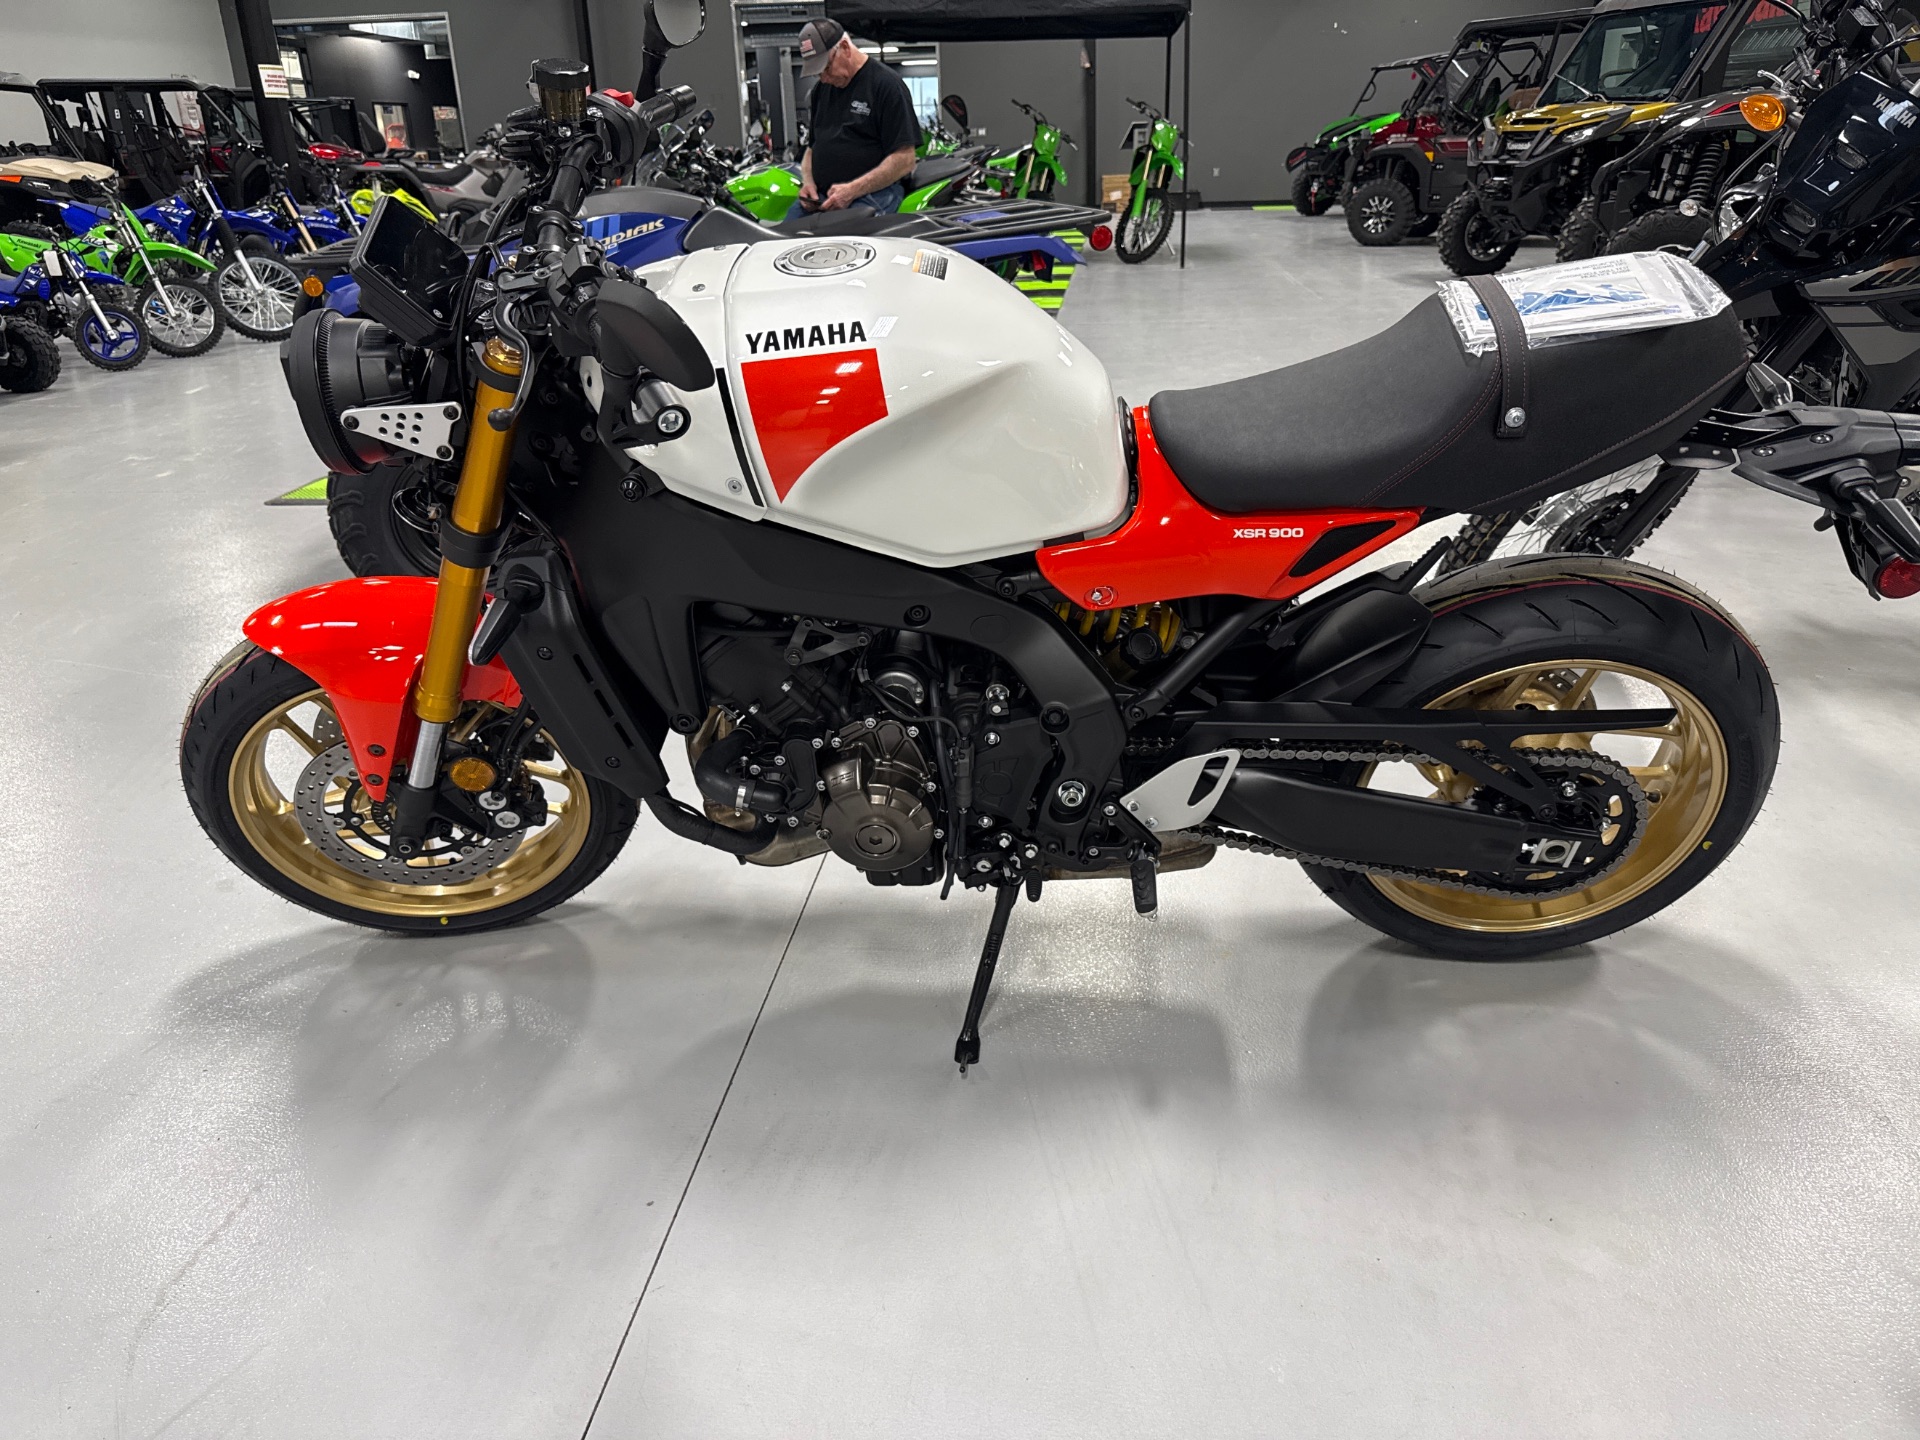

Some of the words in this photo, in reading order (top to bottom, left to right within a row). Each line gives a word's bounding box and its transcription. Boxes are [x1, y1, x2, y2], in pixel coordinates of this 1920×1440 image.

[16, 239, 42, 249] Kawasaki
[745, 321, 867, 355] YAMAHA
[1232, 528, 1267, 539] XSR
[1268, 527, 1304, 538] 900
